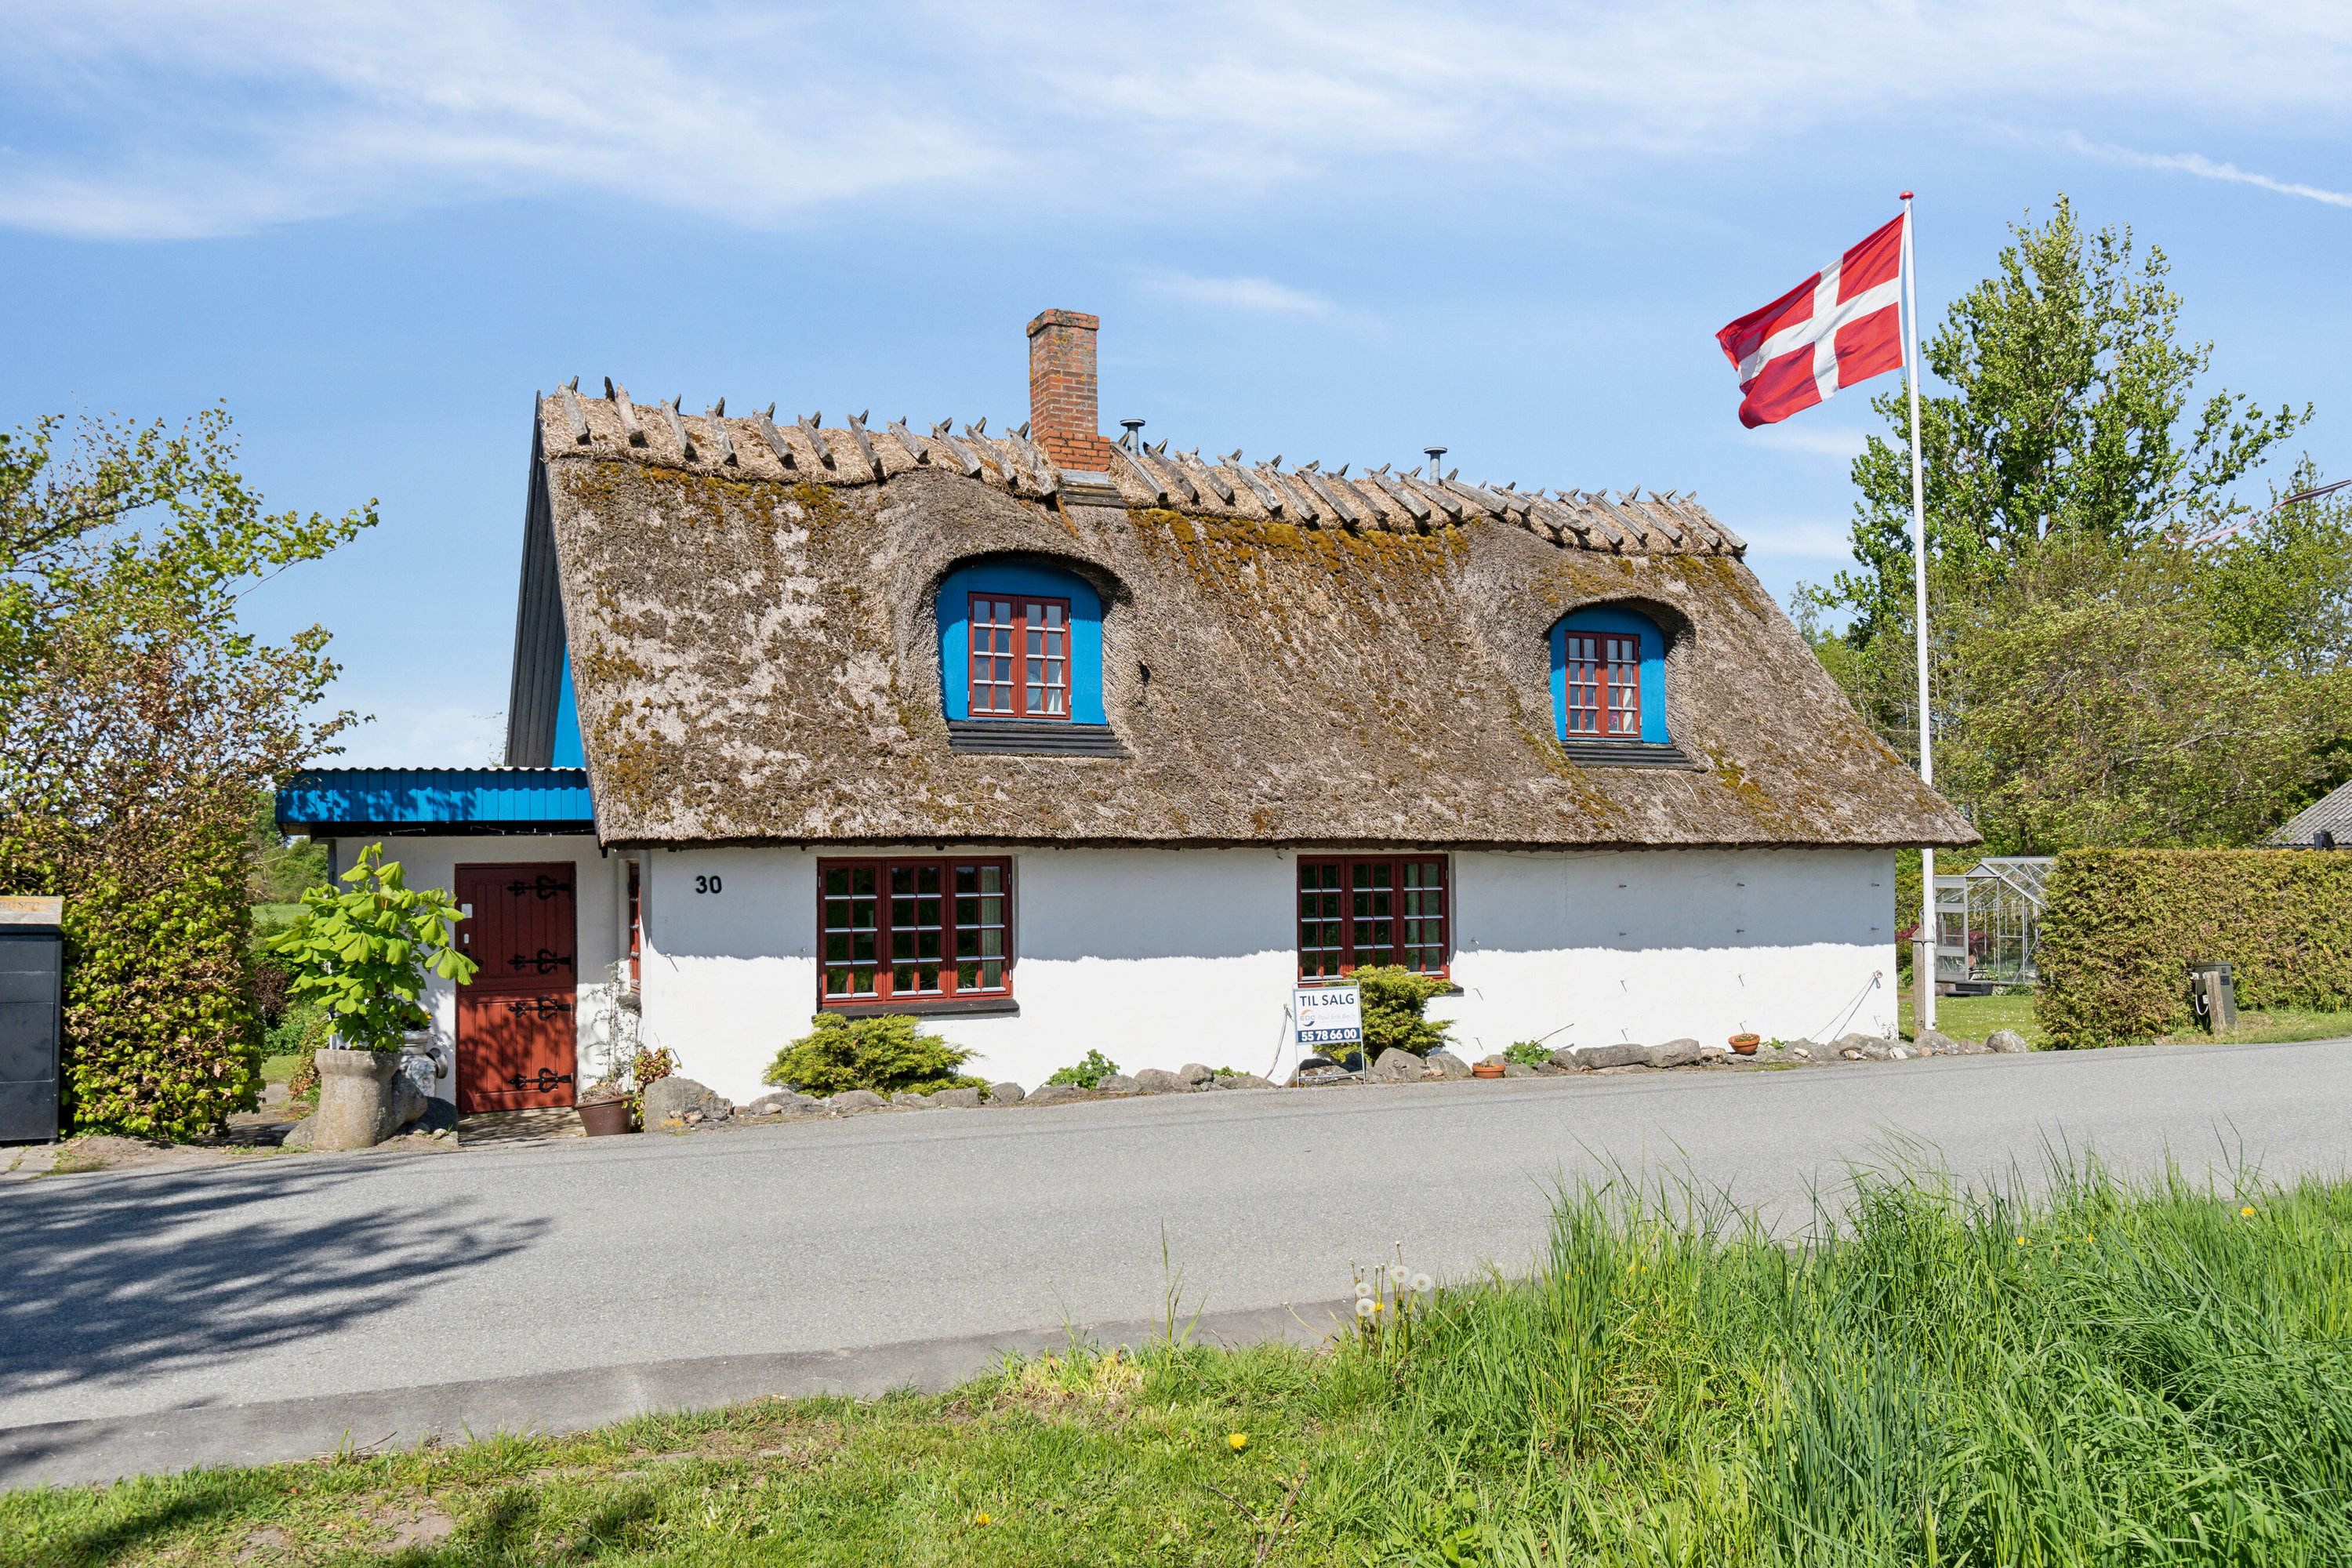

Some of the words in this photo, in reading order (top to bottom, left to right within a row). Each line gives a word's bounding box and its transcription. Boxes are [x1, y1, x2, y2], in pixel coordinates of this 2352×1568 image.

[695, 875, 722, 894] 30
[1299, 995, 1319, 1007] TIL
[1322, 993, 1355, 1006] SALG
[1301, 1031, 1314, 1042] 55
[1315, 1029, 1329, 1040] 78
[1330, 1029, 1343, 1040] 66
[1344, 1029, 1357, 1040] 00
